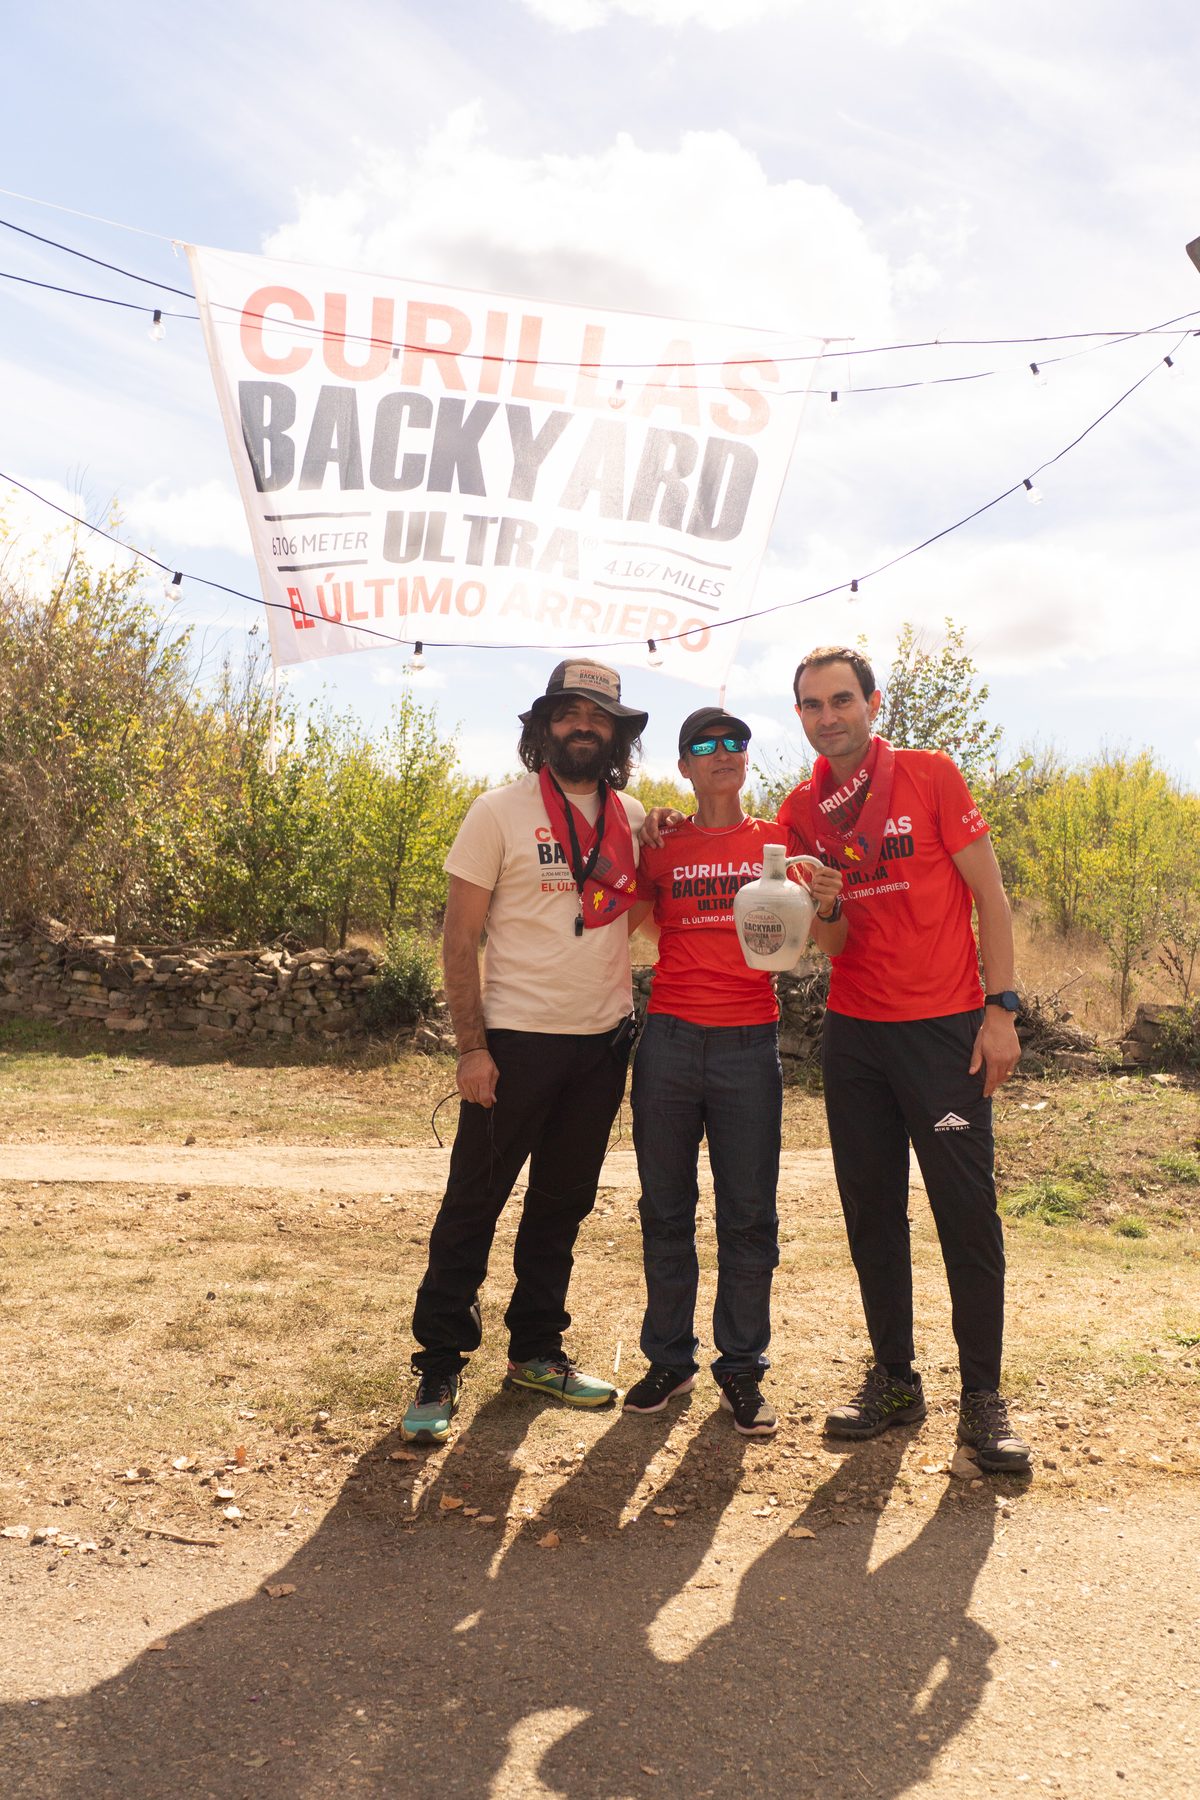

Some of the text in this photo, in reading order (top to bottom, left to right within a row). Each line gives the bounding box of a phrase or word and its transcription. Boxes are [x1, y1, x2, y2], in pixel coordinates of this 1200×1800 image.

[240, 285, 782, 435] CURILLAS
[238, 379, 758, 542] BACKYARD
[301, 531, 369, 554] METER
[382, 510, 580, 581] ULTRA
[604, 559, 725, 598] 4.167 MILES
[286, 572, 712, 653] EL ÚLTIMO ARRIERO
[818, 769, 869, 814] RILLAS
[672, 861, 764, 881] CURILLAS
[541, 882, 554, 892] EL
[876, 881, 910, 895] ARRIERO
[682, 917, 691, 925] EL
[692, 915, 719, 925] ÚLTIMO
[744, 921, 782, 933] BACKYARD
